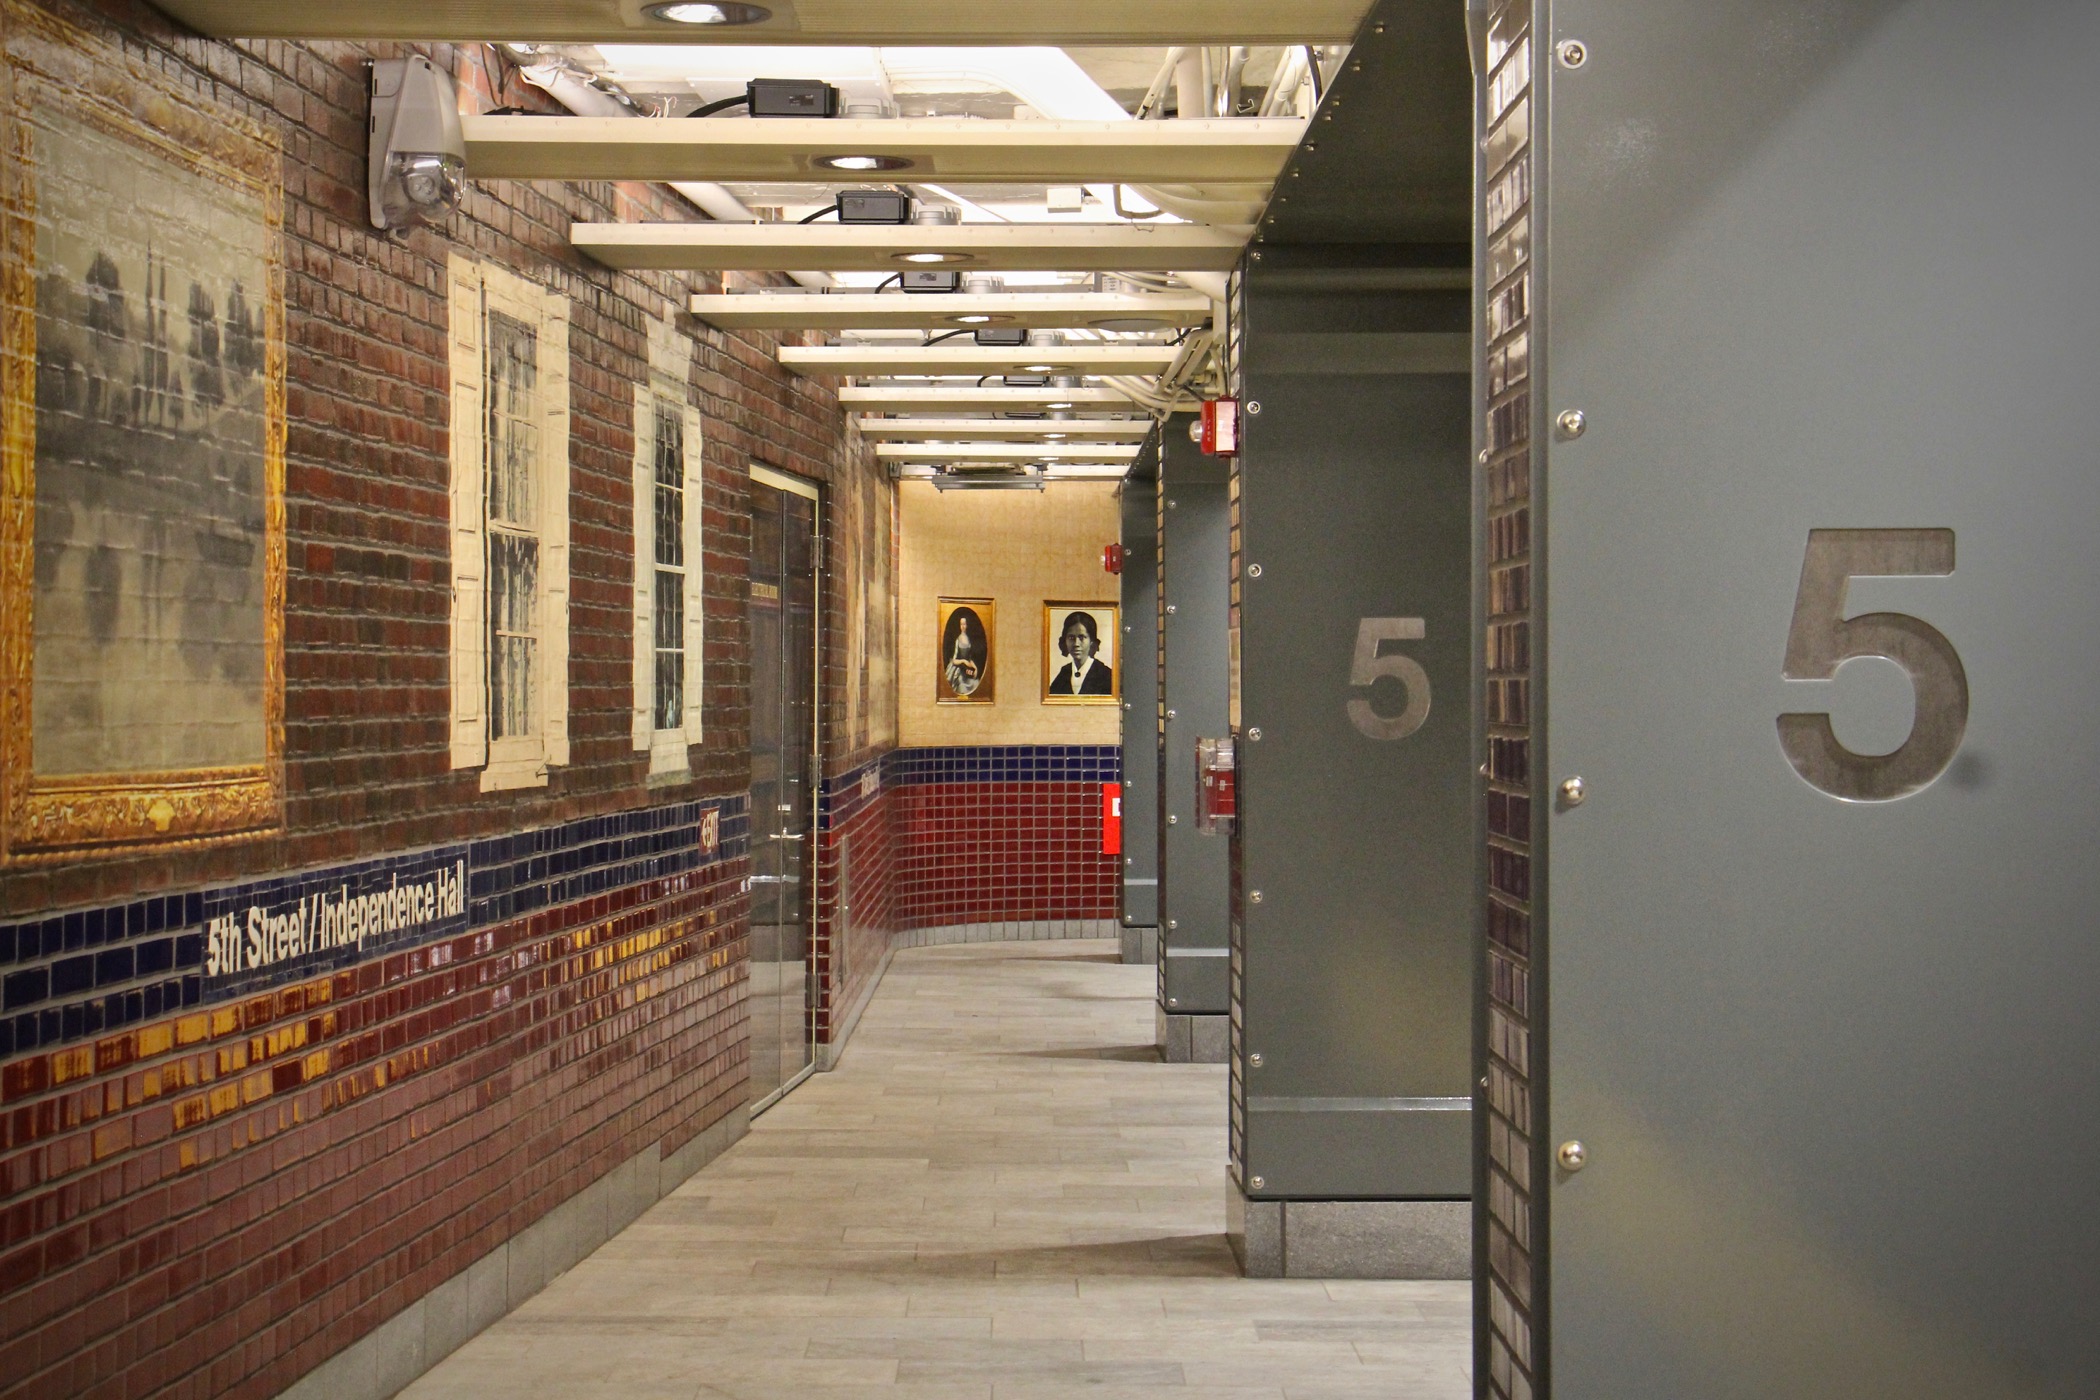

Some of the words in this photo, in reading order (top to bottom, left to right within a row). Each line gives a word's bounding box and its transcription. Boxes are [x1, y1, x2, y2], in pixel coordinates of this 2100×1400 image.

[1346, 617, 1432, 741] 5
[1776, 527, 1969, 805] 5
[207, 911, 242, 977] 5th
[246, 897, 307, 969] Street
[320, 872, 434, 952] Independence
[437, 858, 465, 920] Hall
